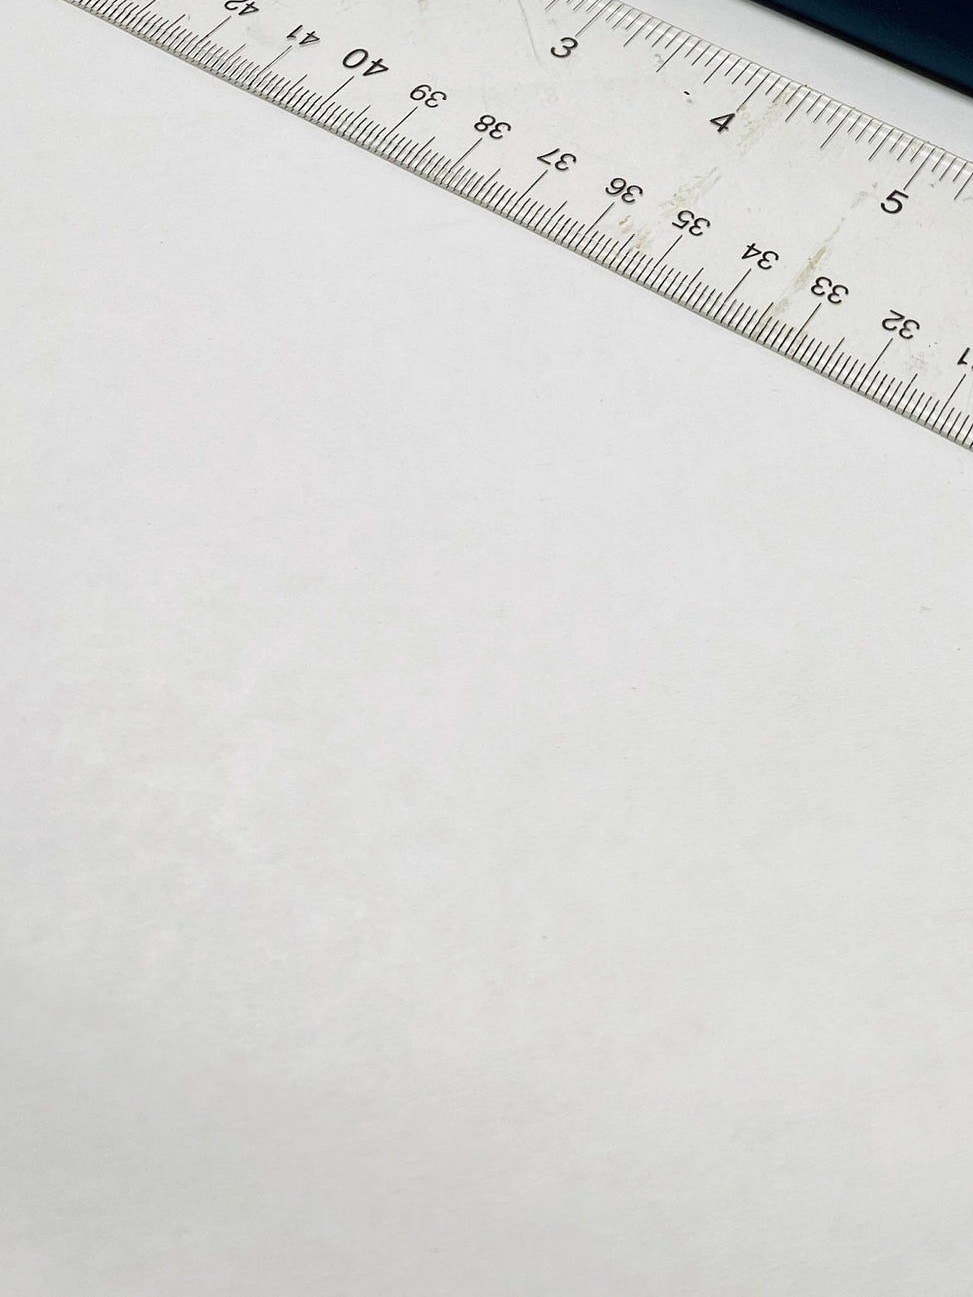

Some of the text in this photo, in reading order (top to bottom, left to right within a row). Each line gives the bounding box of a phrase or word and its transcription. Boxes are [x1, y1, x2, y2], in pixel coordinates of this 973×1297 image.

[287, 25, 320, 46] 41
[551, 37, 578, 58] 3
[342, 49, 389, 76] 40
[410, 85, 447, 108] 39
[474, 115, 511, 140] 38
[710, 113, 736, 133] 4
[537, 147, 577, 171] 37
[606, 178, 643, 203] 36
[881, 190, 909, 213] 5
[672, 210, 711, 236] 35
[741, 243, 779, 269] 34
[811, 276, 848, 304] 33
[882, 310, 920, 339] 32
